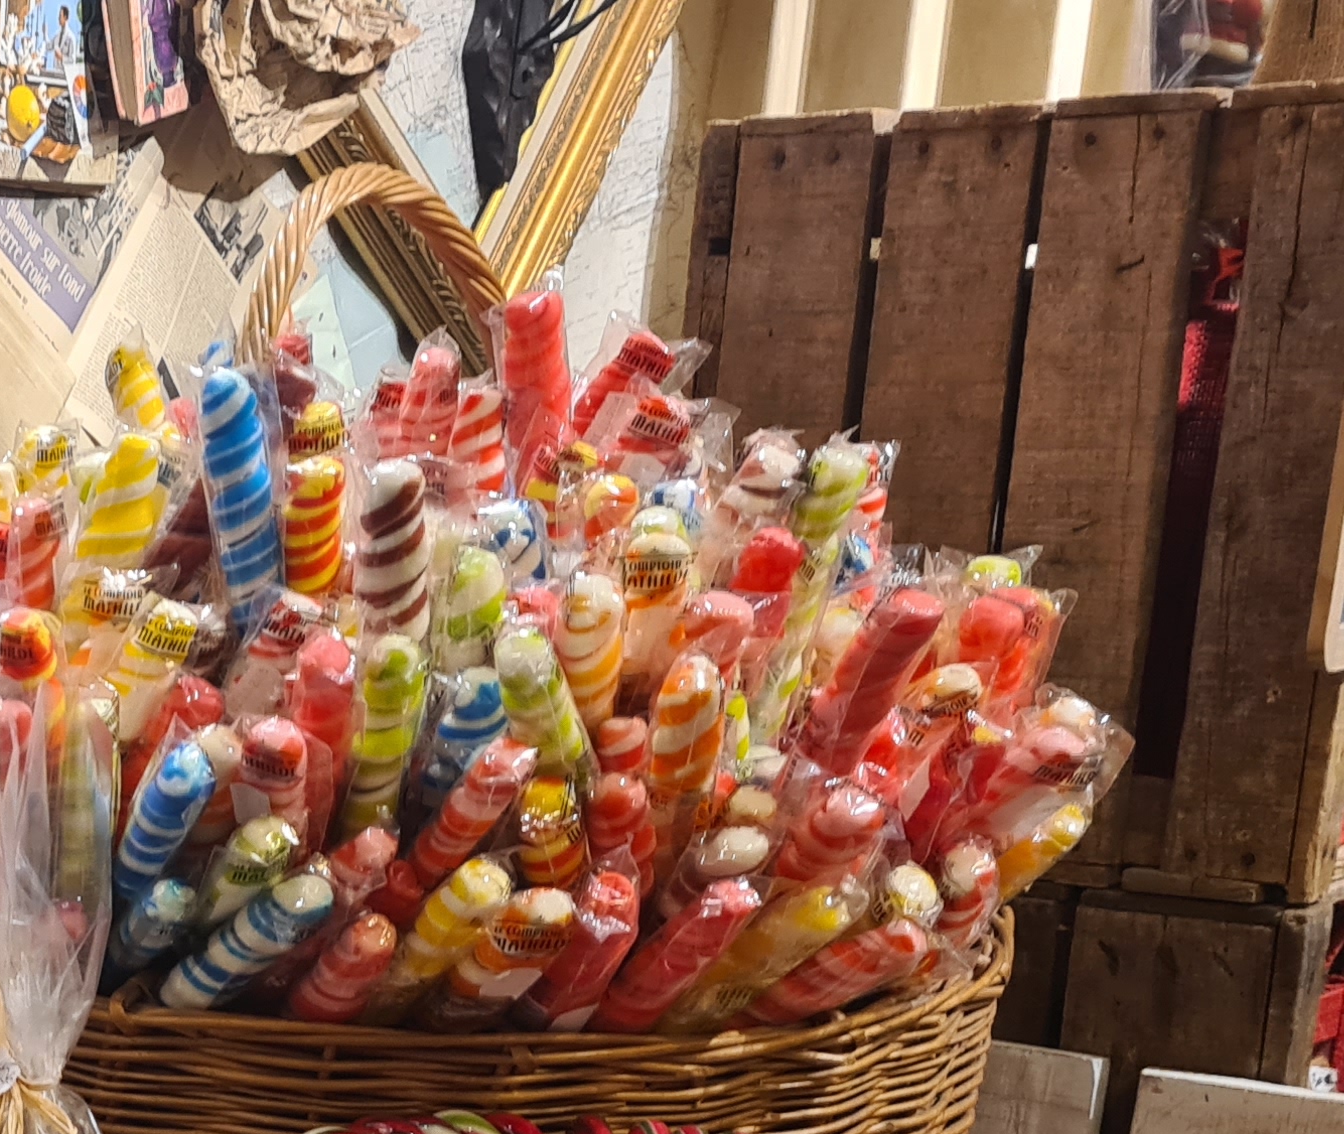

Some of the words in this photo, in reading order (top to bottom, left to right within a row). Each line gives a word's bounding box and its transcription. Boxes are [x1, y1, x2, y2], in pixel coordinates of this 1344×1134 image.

[2, 200, 43, 251] glamour
[39, 241, 62, 271] sur
[56, 261, 88, 303] fond
[19, 251, 52, 300] froide
